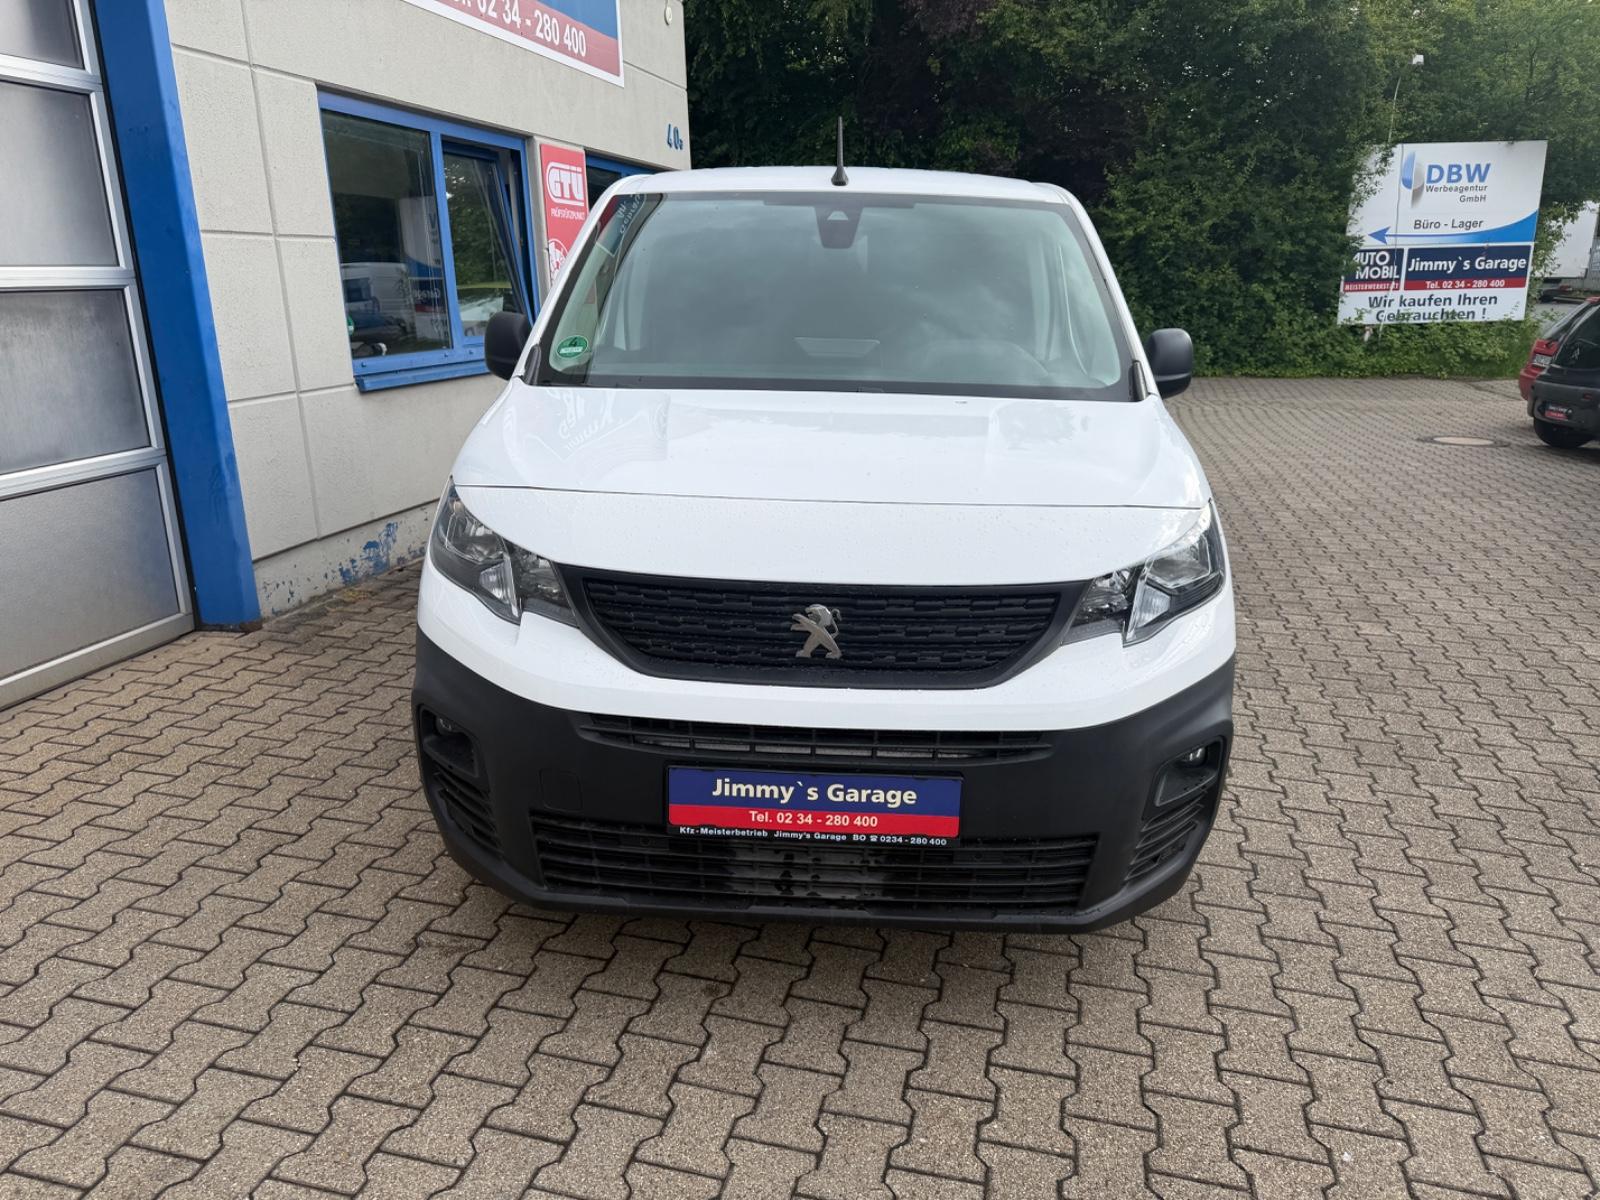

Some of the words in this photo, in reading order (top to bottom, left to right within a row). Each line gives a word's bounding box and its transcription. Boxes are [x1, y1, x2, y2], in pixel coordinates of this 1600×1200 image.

[503, 0, 521, 28] 34
[534, 9, 560, 45] 280
[563, 24, 586, 57] 400
[1426, 163, 1491, 184] DBW
[547, 163, 584, 202] GTÜ
[1425, 184, 1488, 193] Werbeagentur
[1459, 194, 1487, 203] GmbH
[1413, 219, 1441, 230] Büro
[1451, 218, 1484, 230] Lager
[1353, 251, 1390, 265] AUTO
[1474, 256, 1527, 272] Garage
[1355, 265, 1400, 280] MOBIL
[1425, 281, 1440, 289] Tel.
[1442, 281, 1452, 289] 02
[1454, 281, 1465, 289] 34
[1471, 280, 1488, 288] 280
[1489, 279, 1506, 288] 400
[1369, 295, 1394, 308] Wir
[1399, 294, 1452, 308] kaufen
[1457, 293, 1498, 306] Ihren
[1376, 308, 1476, 322] Gebrauchten
[569, 337, 579, 347] 4
[827, 783, 917, 808] Garage
[749, 810, 773, 824] Tel.
[776, 812, 792, 825] 02
[797, 813, 813, 825] 34
[825, 815, 850, 827] 280
[853, 816, 878, 828] 400
[774, 830, 811, 840] Jimmy's
[814, 832, 847, 841] Garage
[910, 837, 927, 845] 280
[929, 838, 947, 846] 400
